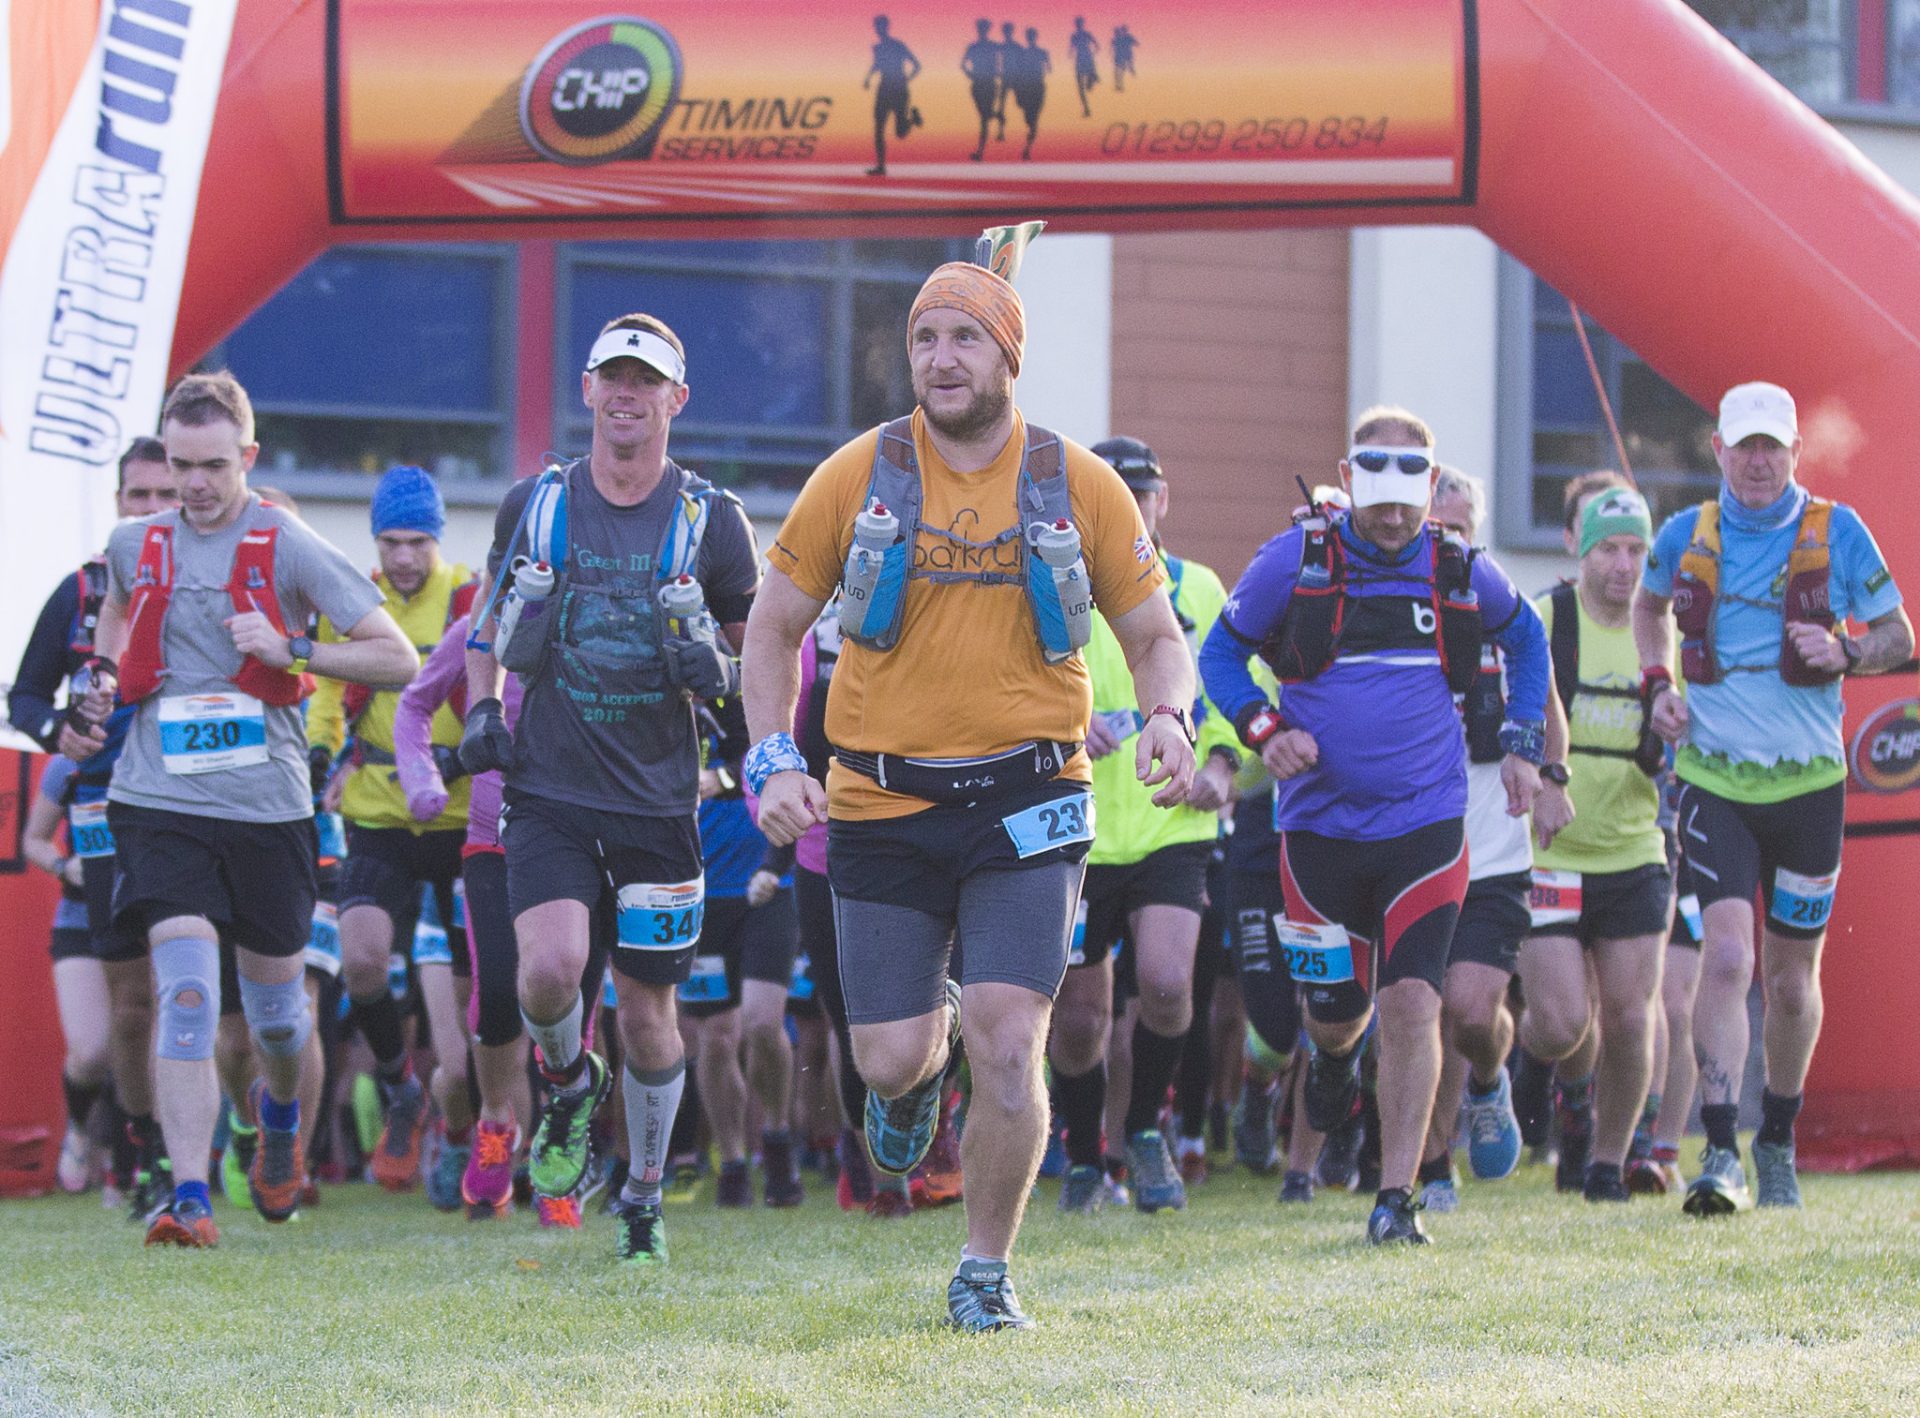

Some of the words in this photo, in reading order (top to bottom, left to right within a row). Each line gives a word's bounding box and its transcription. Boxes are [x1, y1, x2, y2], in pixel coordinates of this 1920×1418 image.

[552, 67, 649, 111] CHIP
[676, 96, 832, 131] TIMING
[659, 134, 817, 161] SERVICES
[1101, 120, 1225, 154] 01299
[1231, 118, 1308, 153] 250
[1314, 116, 1389, 150] 834
[183, 720, 241, 752] 230
[1239, 907, 1271, 971] EMILY
